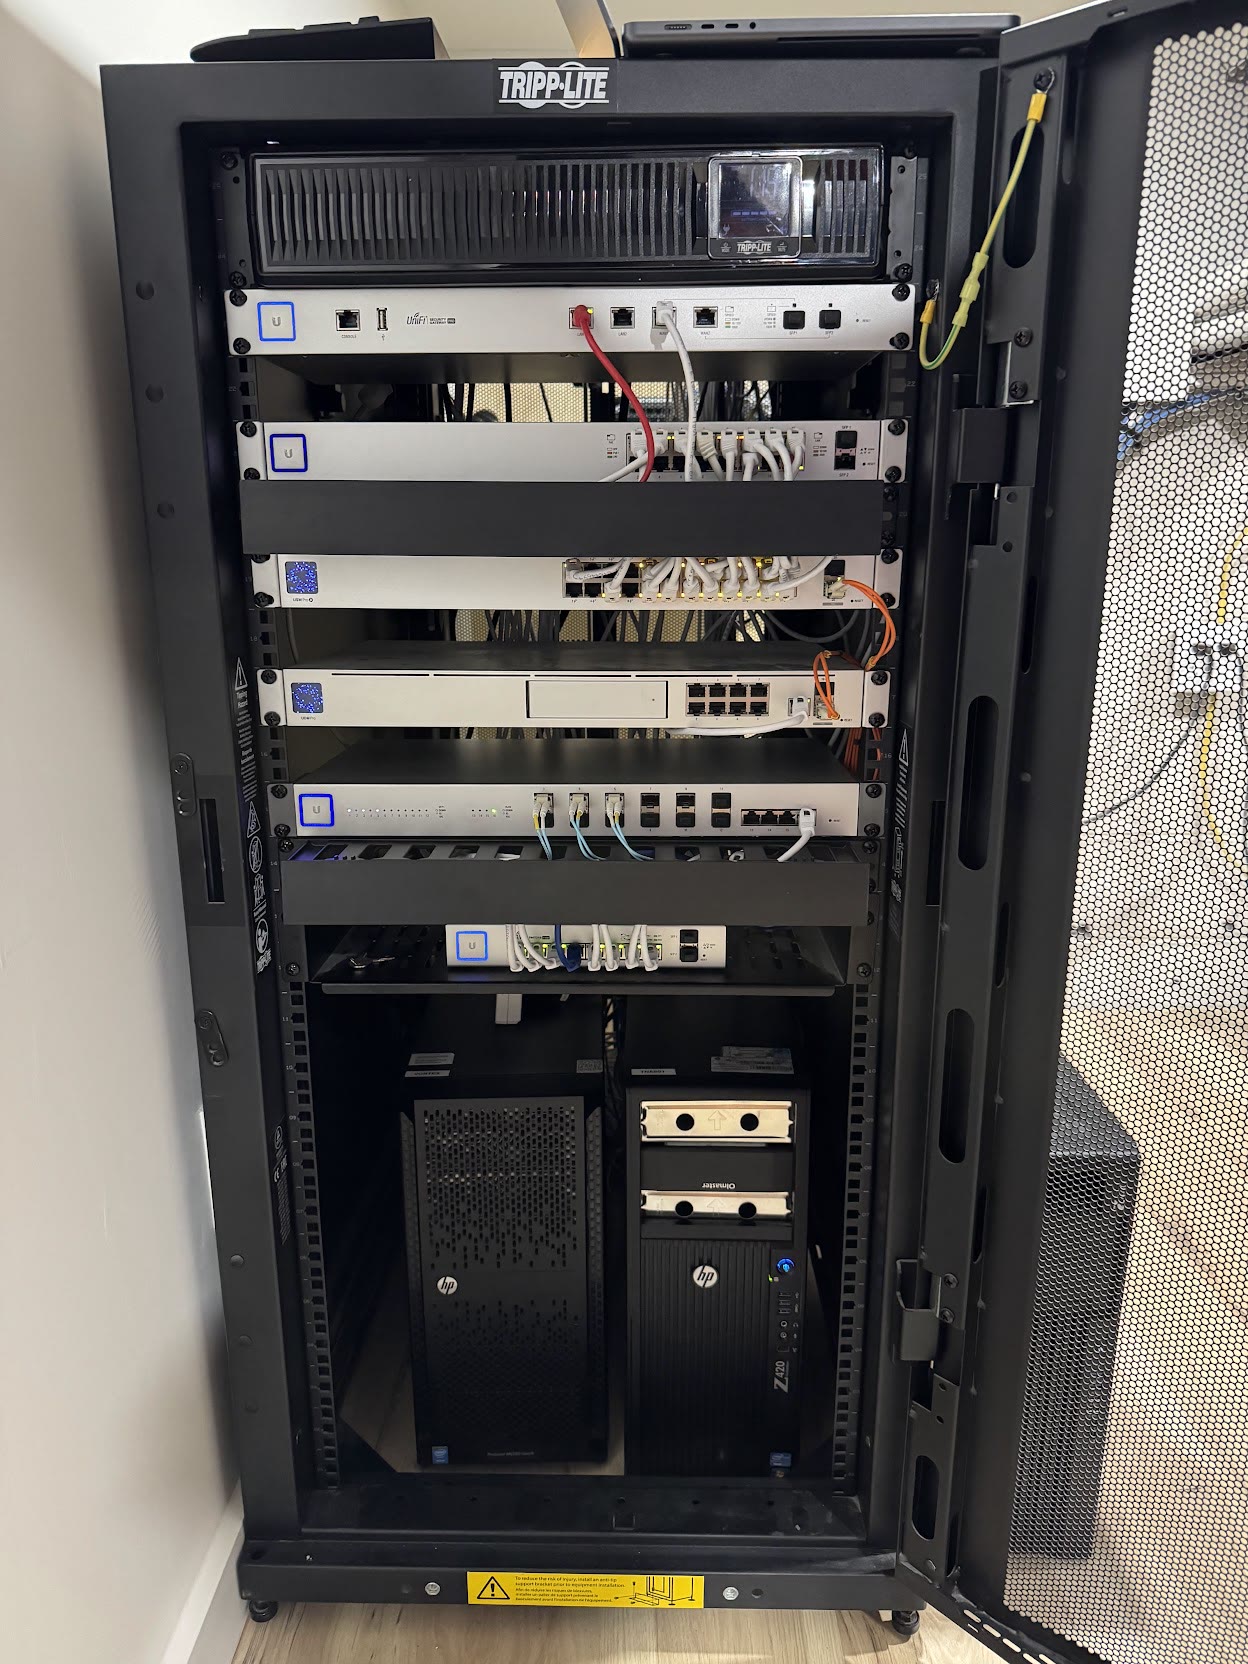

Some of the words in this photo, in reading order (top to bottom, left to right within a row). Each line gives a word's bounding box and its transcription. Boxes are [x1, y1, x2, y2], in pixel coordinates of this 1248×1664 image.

[439, 1276, 456, 1295] hp
[696, 1265, 716, 1288] hp
[773, 1360, 788, 1393] Z420
